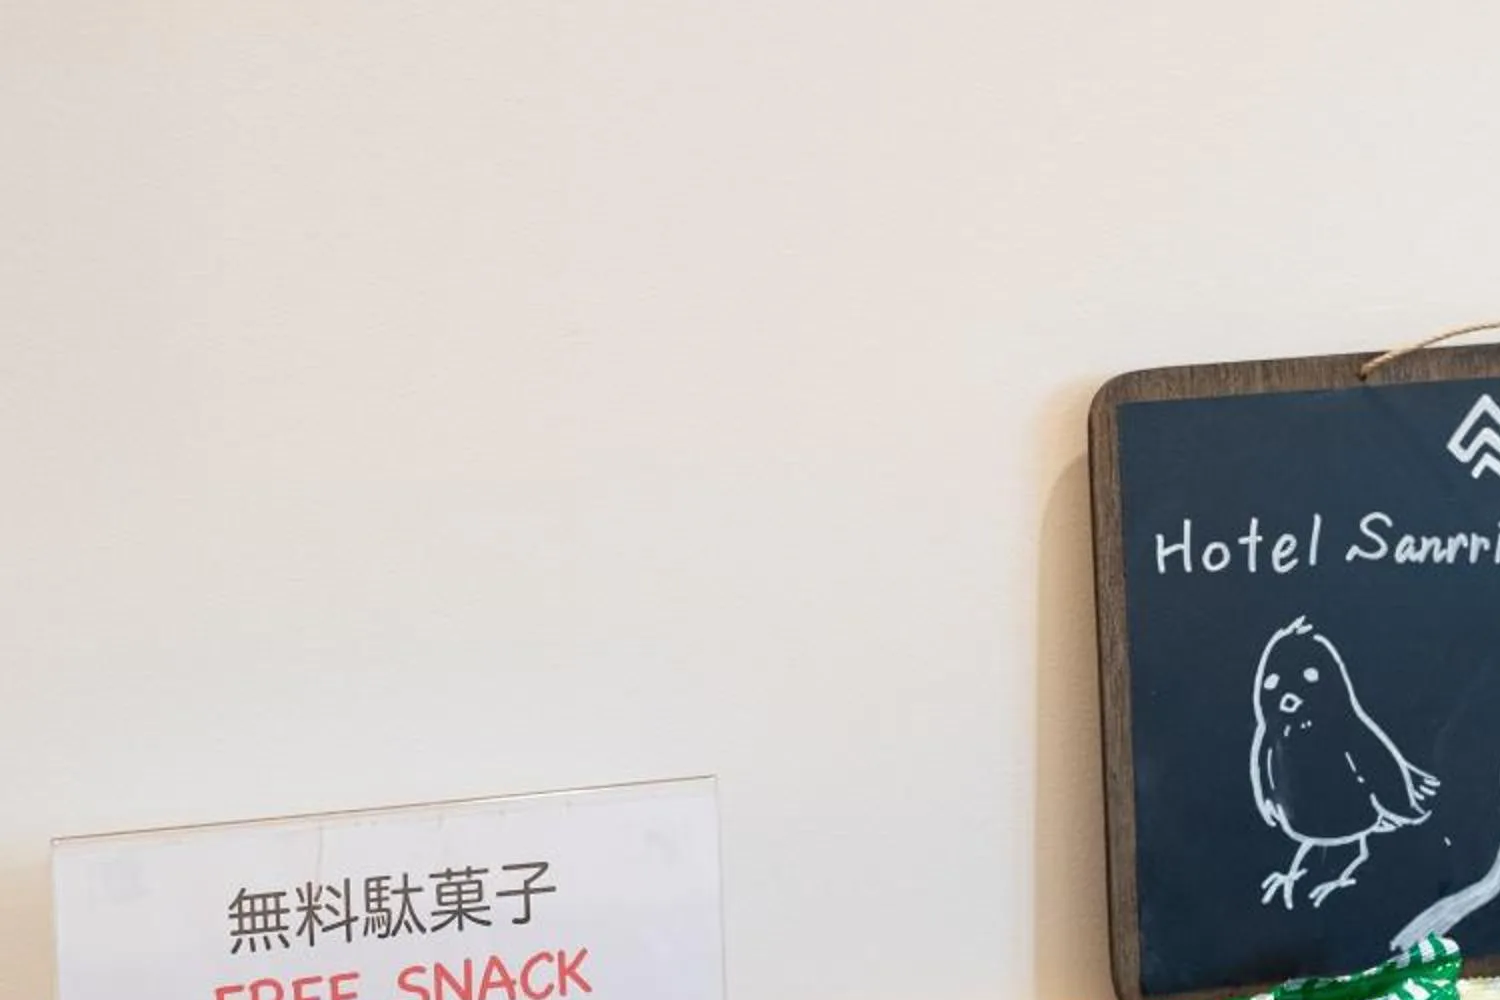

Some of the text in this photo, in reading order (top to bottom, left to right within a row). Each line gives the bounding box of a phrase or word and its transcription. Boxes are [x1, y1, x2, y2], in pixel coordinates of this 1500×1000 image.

[1155, 512, 1322, 574] Hotel
[227, 861, 557, 955] 無料駄菓子
